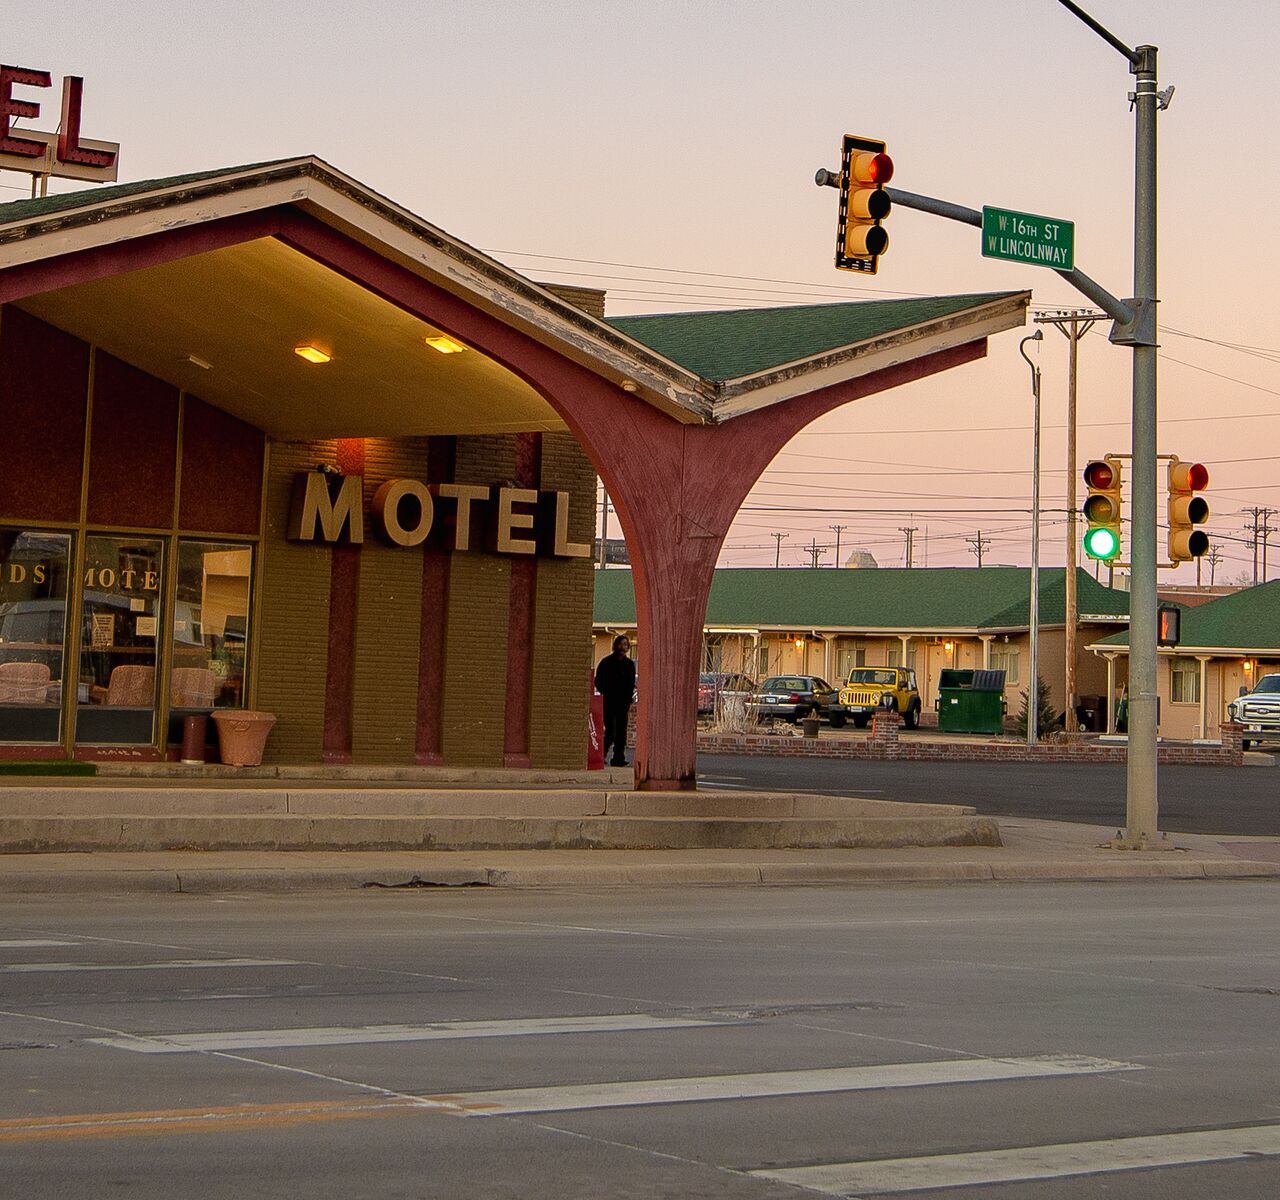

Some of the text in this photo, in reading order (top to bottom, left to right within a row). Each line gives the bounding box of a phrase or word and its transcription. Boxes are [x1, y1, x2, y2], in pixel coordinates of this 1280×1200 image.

[1044, 224, 1060, 241] ST
[988, 235, 1068, 264] W LINCOLNWAY
[295, 471, 592, 558] MOTEL
